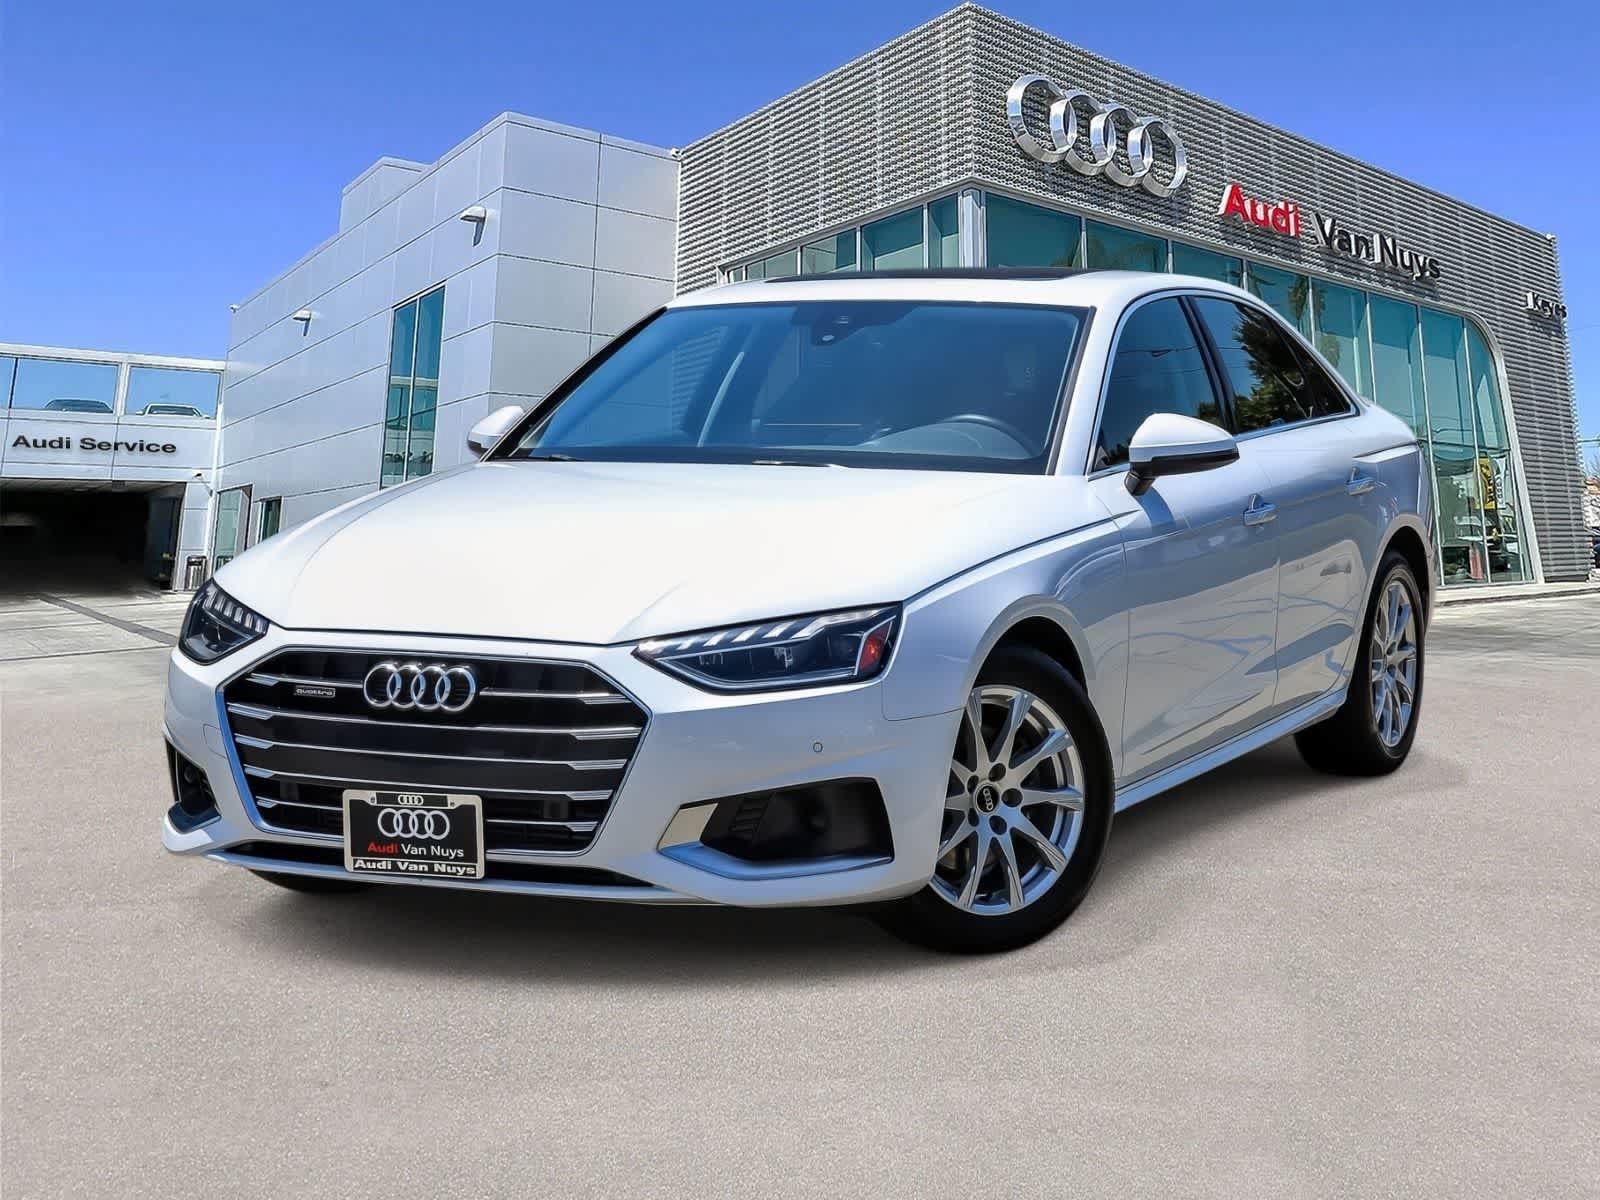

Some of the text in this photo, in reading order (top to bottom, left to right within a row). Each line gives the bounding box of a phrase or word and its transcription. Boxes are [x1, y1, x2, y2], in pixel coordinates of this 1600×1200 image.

[1217, 183, 1442, 281] Audi Van Nuys
[12, 434, 177, 454] Audi Service
[367, 842, 465, 860] Audi Van Nuys
[354, 859, 477, 876] Audi Van Nuys
